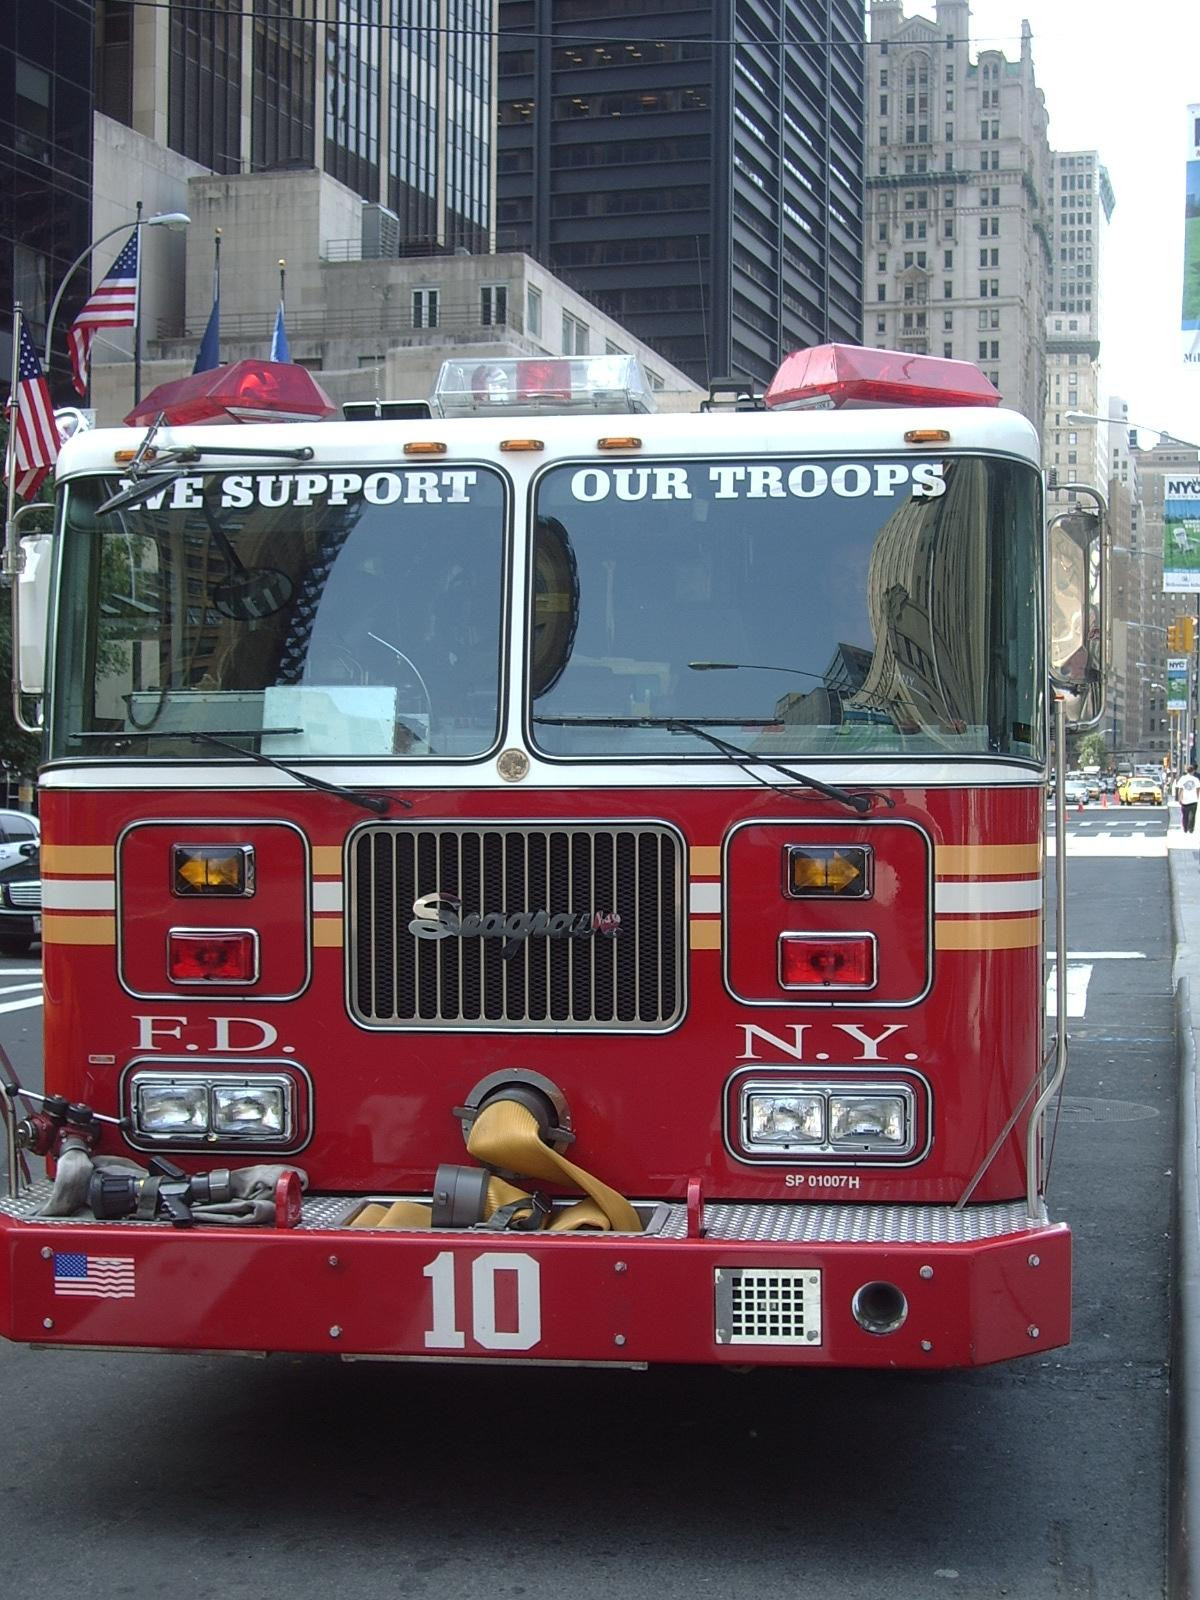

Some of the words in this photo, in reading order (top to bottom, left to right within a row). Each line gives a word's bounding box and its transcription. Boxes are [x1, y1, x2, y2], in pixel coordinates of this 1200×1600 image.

[222, 471, 477, 508] SUPPORT
[571, 468, 692, 501] OUR
[709, 463, 947, 498] TROOPS
[131, 1016, 295, 1053] F.D.
[735, 1023, 918, 1060] N.Y.
[785, 1174, 804, 1187] SP
[423, 1251, 541, 1350] 10
